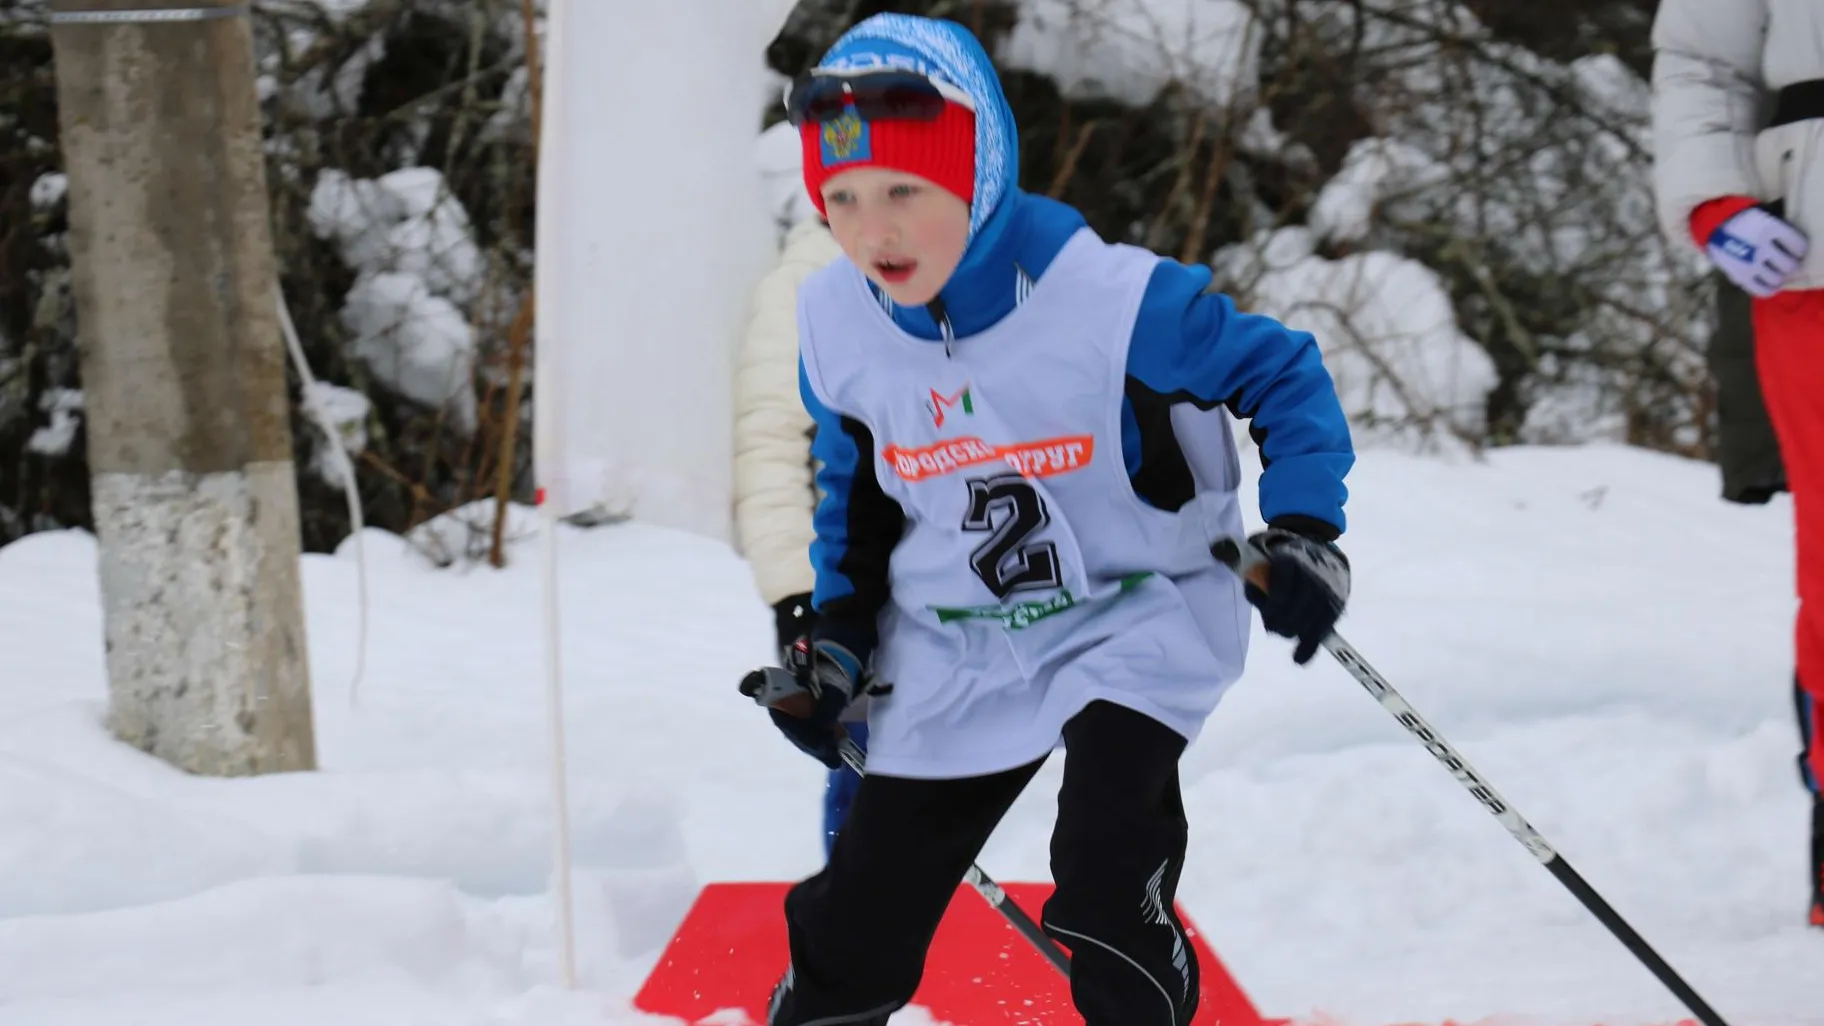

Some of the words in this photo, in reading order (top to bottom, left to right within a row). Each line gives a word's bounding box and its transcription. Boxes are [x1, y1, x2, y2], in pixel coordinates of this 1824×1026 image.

[893, 439, 996, 477] ОРОДСК
[961, 471, 1063, 599] 2
[1393, 711, 1507, 815] SPORTER
